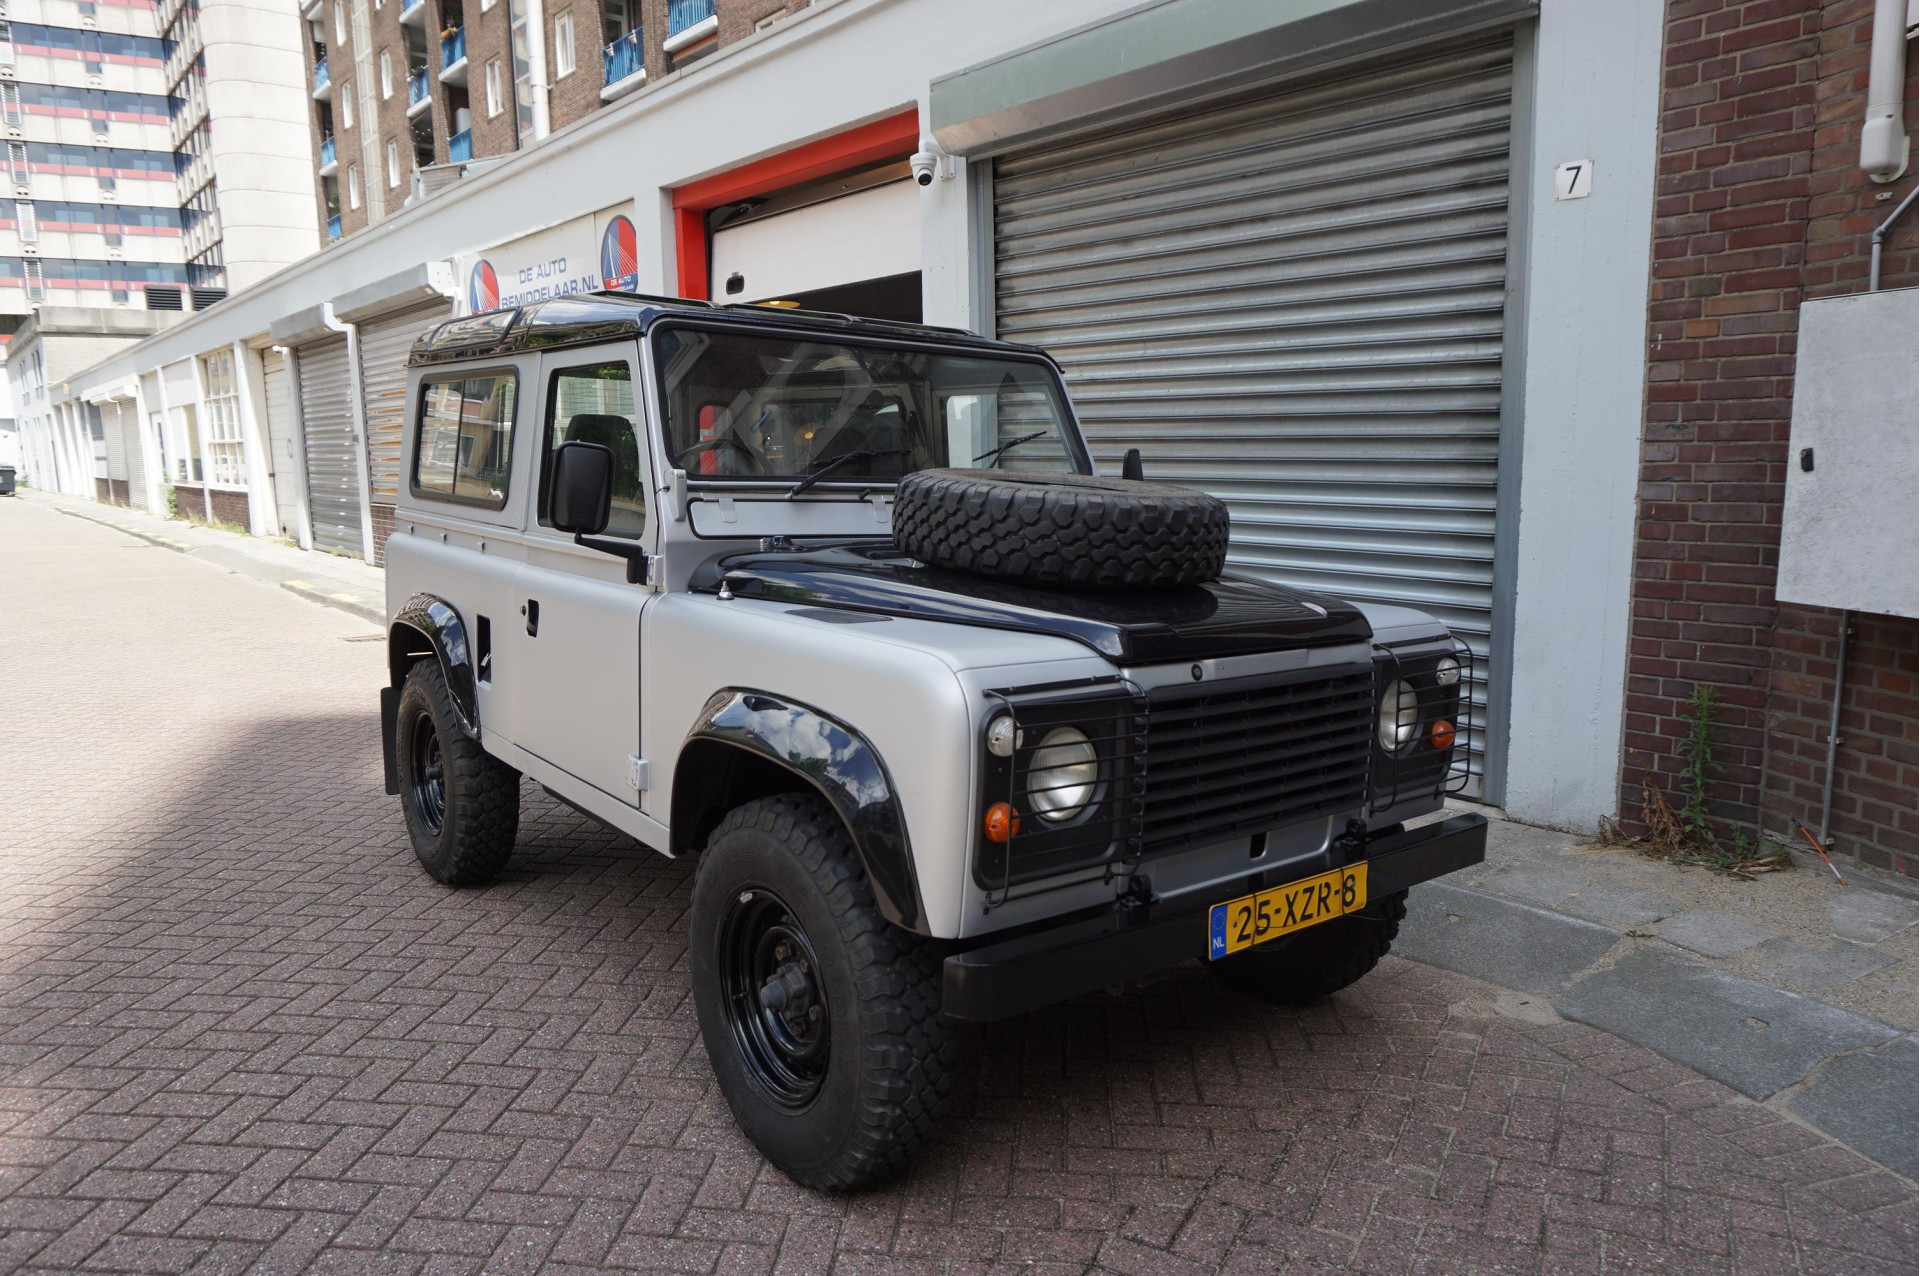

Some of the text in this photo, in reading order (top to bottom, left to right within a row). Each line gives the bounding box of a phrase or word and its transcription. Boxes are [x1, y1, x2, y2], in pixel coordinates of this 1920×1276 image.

[1566, 165, 1582, 194] 7
[519, 257, 567, 284] DE AUTO
[1236, 874, 1356, 943] 25-XZR-8
[1213, 937, 1225, 949] NL
